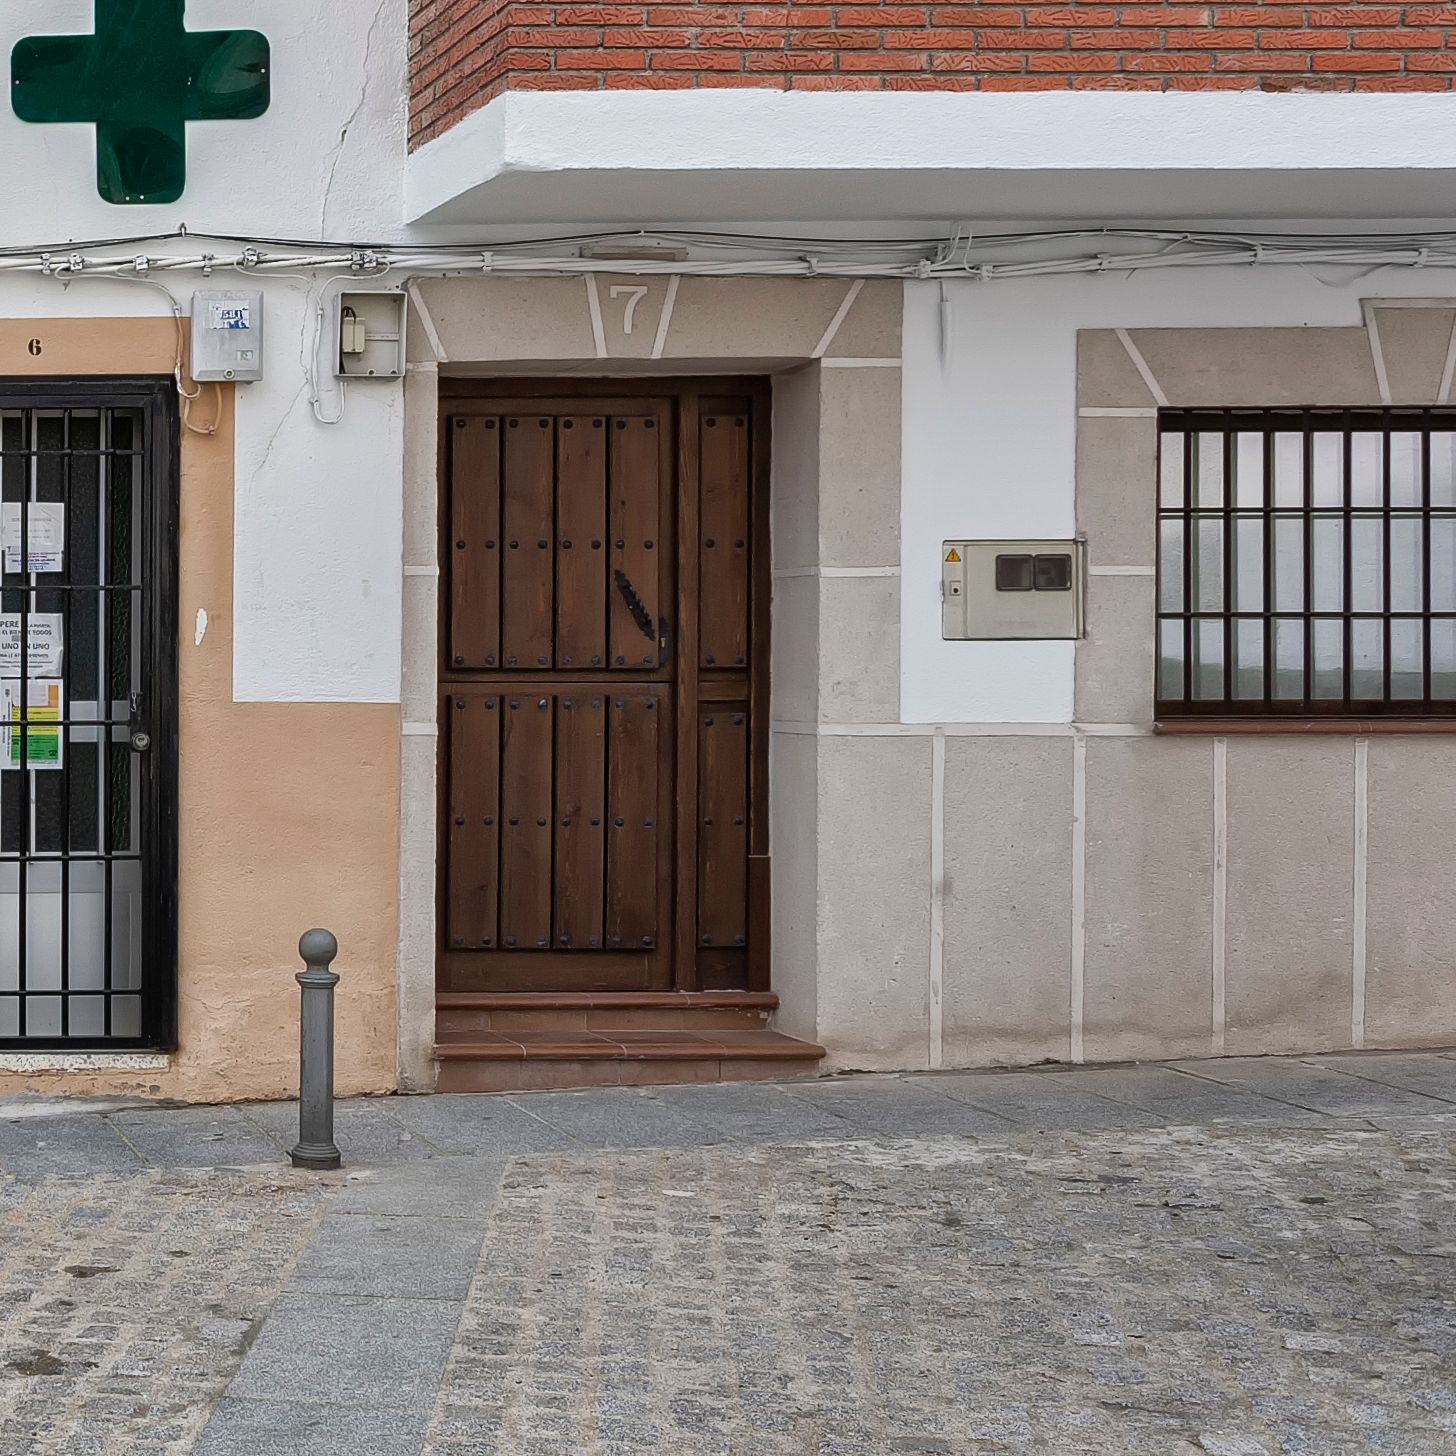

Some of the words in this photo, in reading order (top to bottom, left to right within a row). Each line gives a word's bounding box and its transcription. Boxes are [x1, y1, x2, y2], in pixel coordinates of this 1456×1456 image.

[609, 285, 648, 334] 7
[27, 338, 42, 356] 6
[1, 642, 19, 650] UNO
